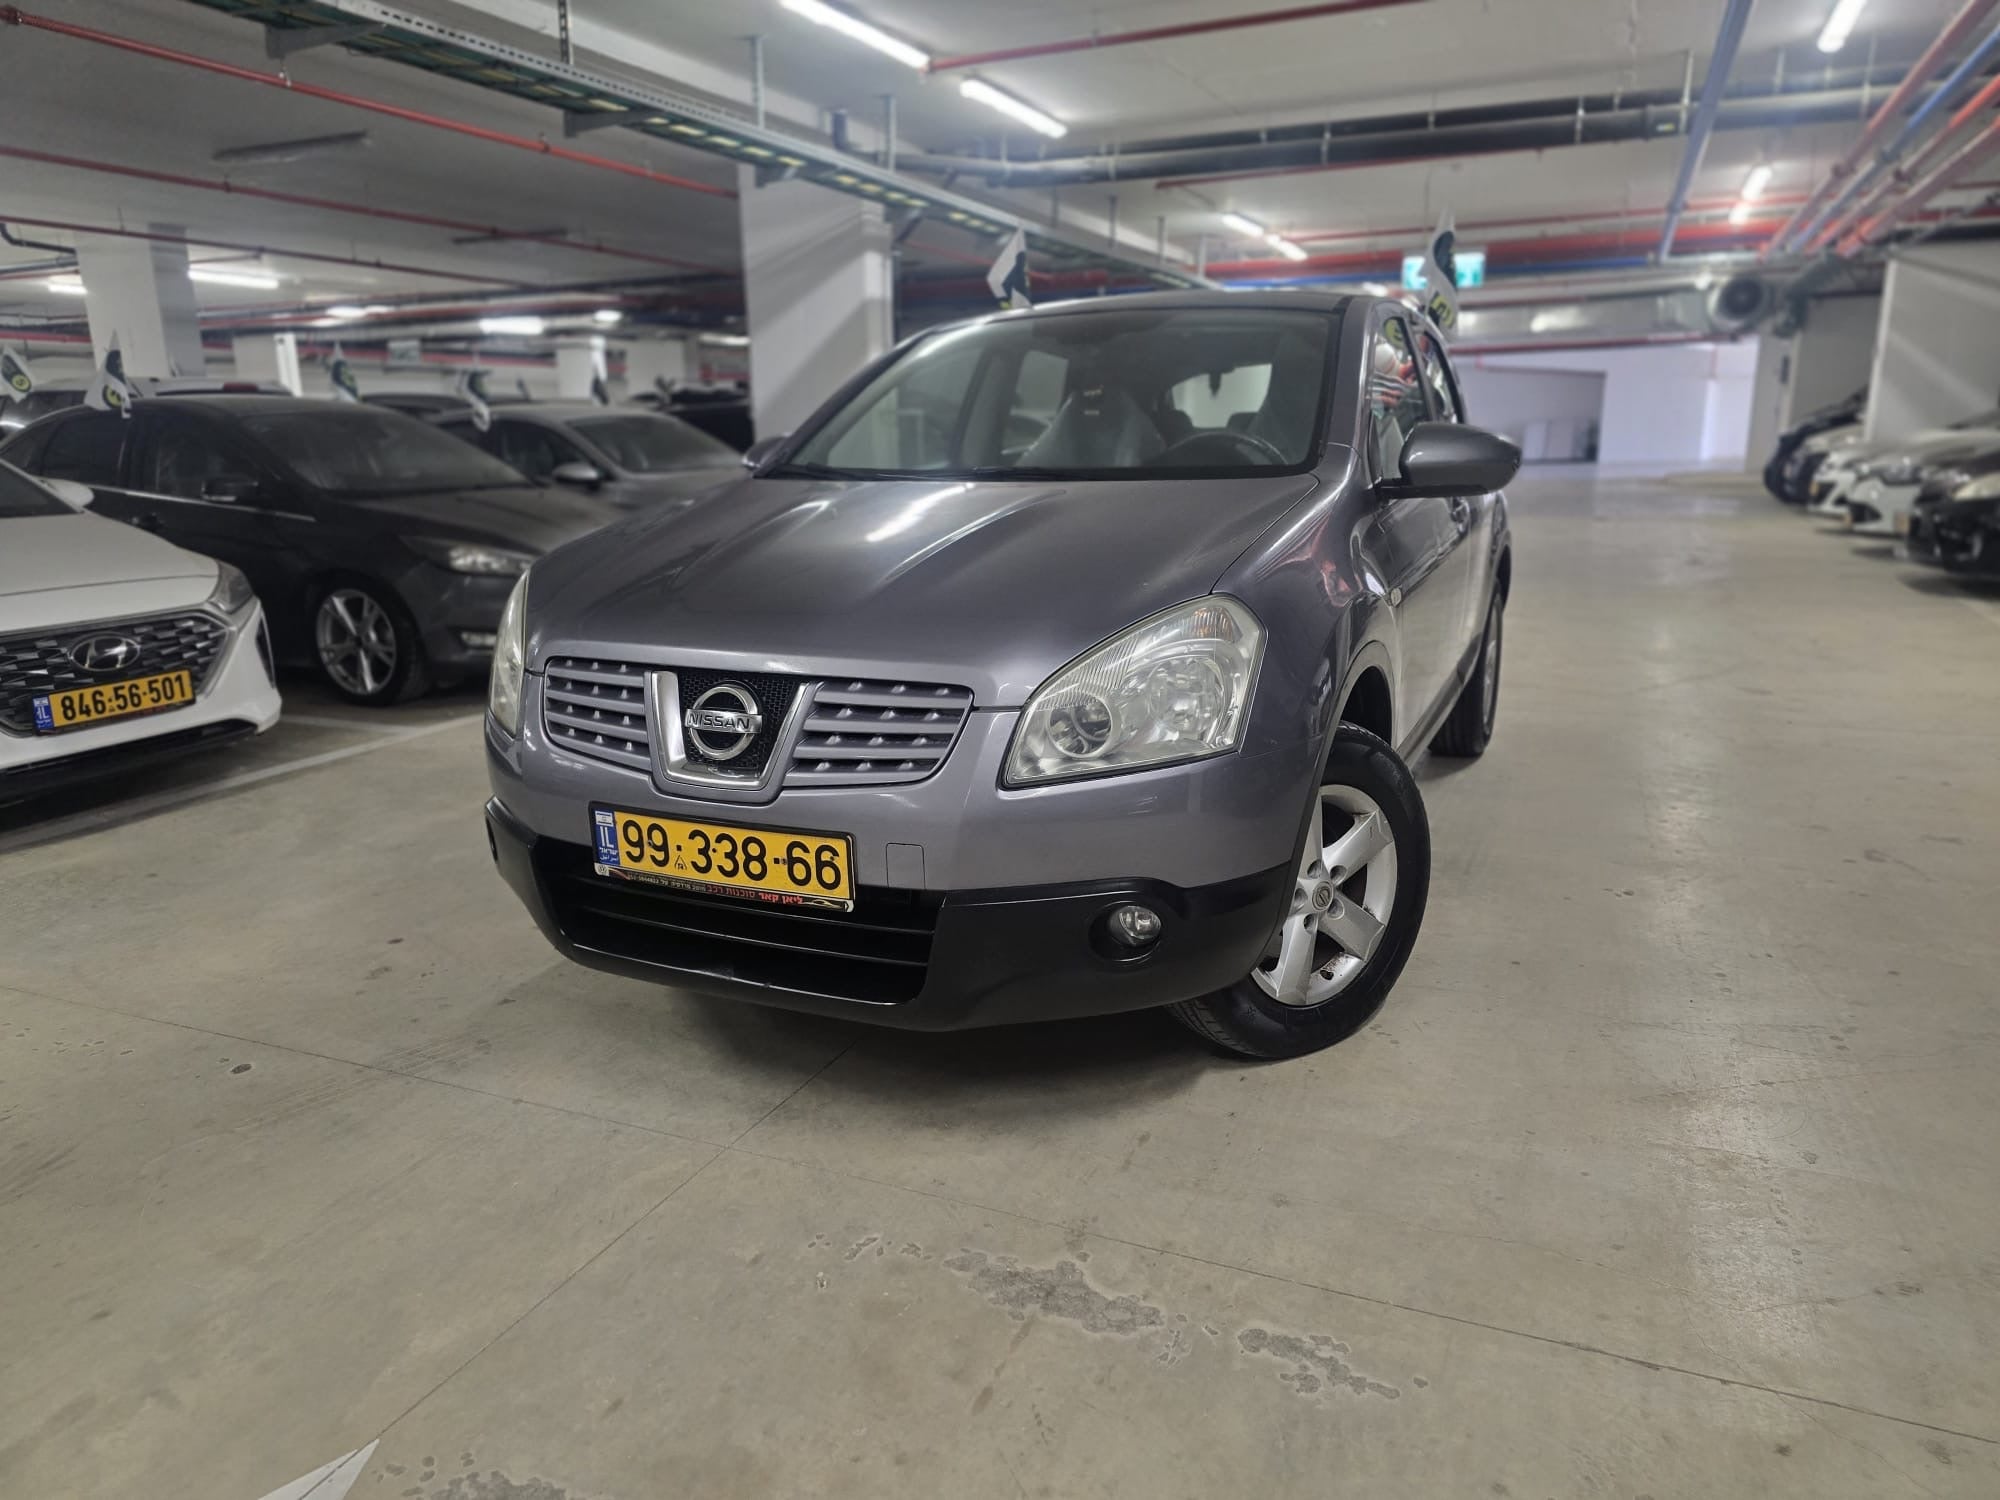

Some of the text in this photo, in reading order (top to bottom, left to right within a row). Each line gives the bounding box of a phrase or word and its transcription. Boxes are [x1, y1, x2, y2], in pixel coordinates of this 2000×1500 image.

[687, 714, 750, 729] NISSAN
[600, 826, 614, 848] IL
[706, 884, 723, 894] רכב
[726, 887, 755, 898] סוכנות
